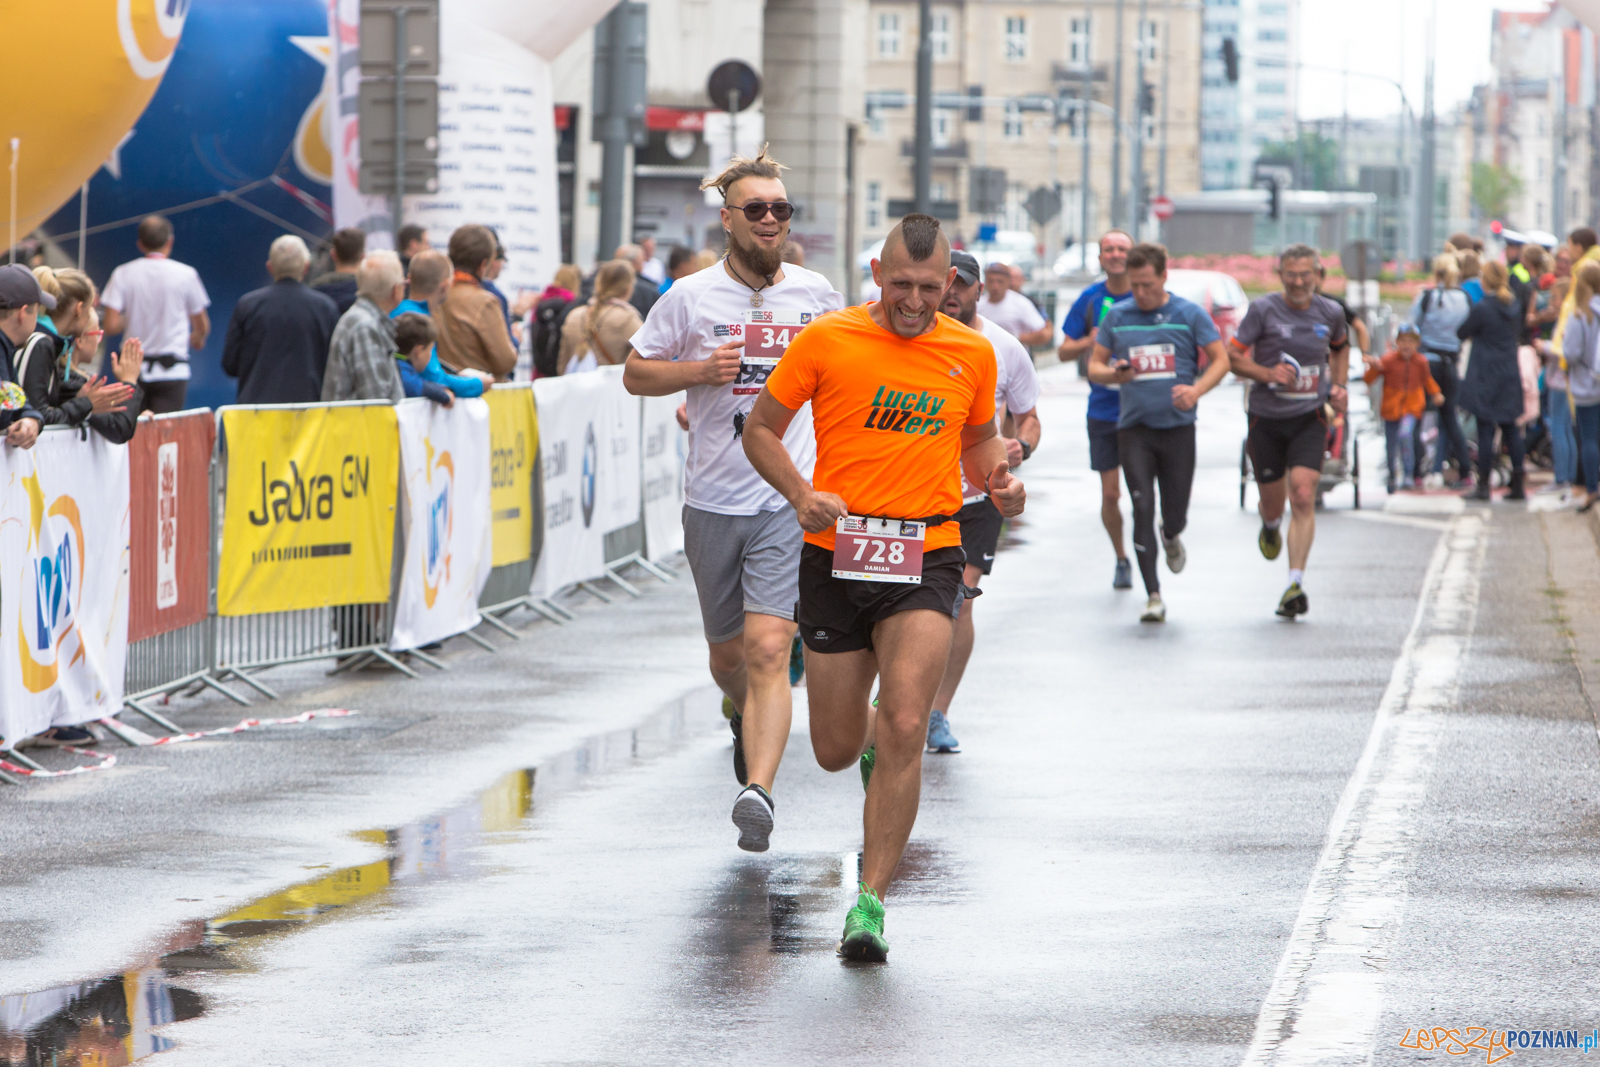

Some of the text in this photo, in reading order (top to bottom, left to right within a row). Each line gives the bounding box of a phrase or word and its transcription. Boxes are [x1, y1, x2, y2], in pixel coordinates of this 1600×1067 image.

[760, 327, 797, 348] 34
[1138, 354, 1167, 371] 912
[871, 385, 946, 416] Lucky
[864, 407, 946, 436] LUZers
[248, 455, 370, 526] Jabra GN
[852, 538, 905, 564] 728
